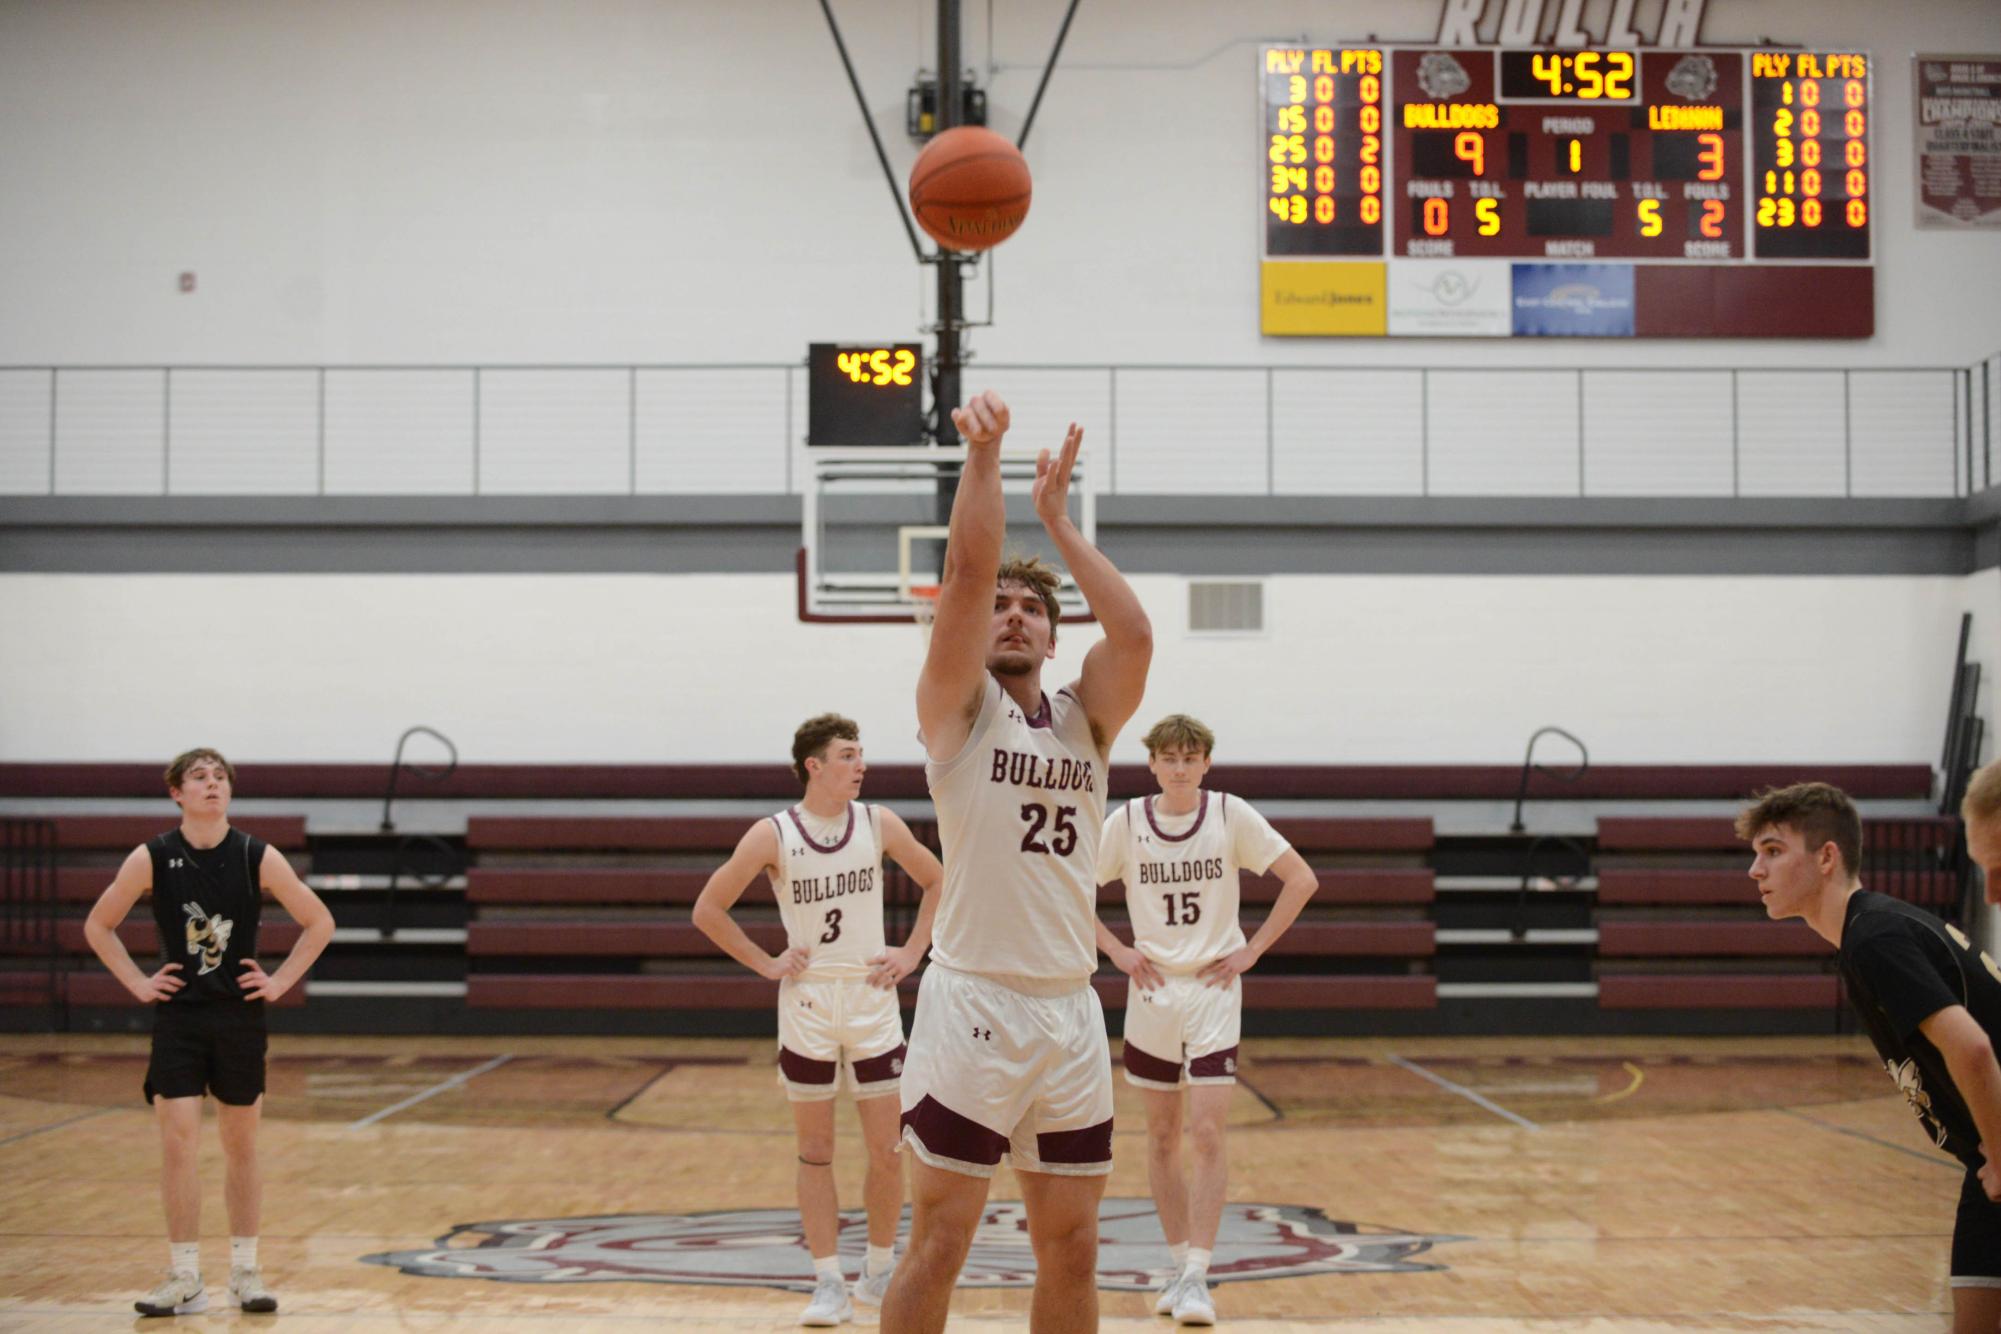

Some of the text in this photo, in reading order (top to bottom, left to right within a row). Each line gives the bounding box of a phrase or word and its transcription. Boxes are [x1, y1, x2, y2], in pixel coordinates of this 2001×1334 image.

[1438, 0, 1704, 47] ROLLA
[1266, 49, 1382, 75] PLY FL PTS
[1532, 51, 1634, 100] 4:52
[1752, 53, 1867, 79] PLY FL PTS
[1289, 75, 1380, 104] 3 0 0
[1782, 79, 1865, 108] 1 0 0
[1279, 105, 1380, 134] 15 0 0
[1404, 103, 1499, 129] BULLDOGS
[1542, 117, 1595, 135] PERIOD
[1773, 108, 1866, 138] 2 0 0
[1269, 134, 1380, 164] 25 0 2
[1454, 131, 1484, 177] 9
[1569, 139, 1581, 173] 1
[1697, 133, 1724, 181] 3
[1776, 137, 1866, 168] 3 0 0
[1271, 164, 1380, 194] 34 0 0
[1407, 181, 1455, 198] FOULS
[1523, 182, 1619, 199] PLAYER FOUL
[1684, 182, 1730, 200] FOULS
[1765, 168, 1866, 198] 11 0 0
[1269, 194, 1380, 224] 43 0 0
[1423, 196, 1449, 237] 0
[1475, 197, 1501, 237] 5
[1637, 198, 1663, 237] 5
[1700, 198, 1725, 238] 2
[1756, 197, 1867, 228] 23 0 0
[1407, 240, 1455, 257] SCORE
[1545, 241, 1595, 257] MATCH
[1684, 241, 1730, 258] SCORE
[837, 350, 916, 386] 4:52
[1021, 802, 1078, 857] 25
[792, 866, 875, 904] BULLDOGS
[1140, 857, 1222, 884] BULLDOGS
[1163, 891, 1201, 926] 15
[820, 908, 843, 944] 3
